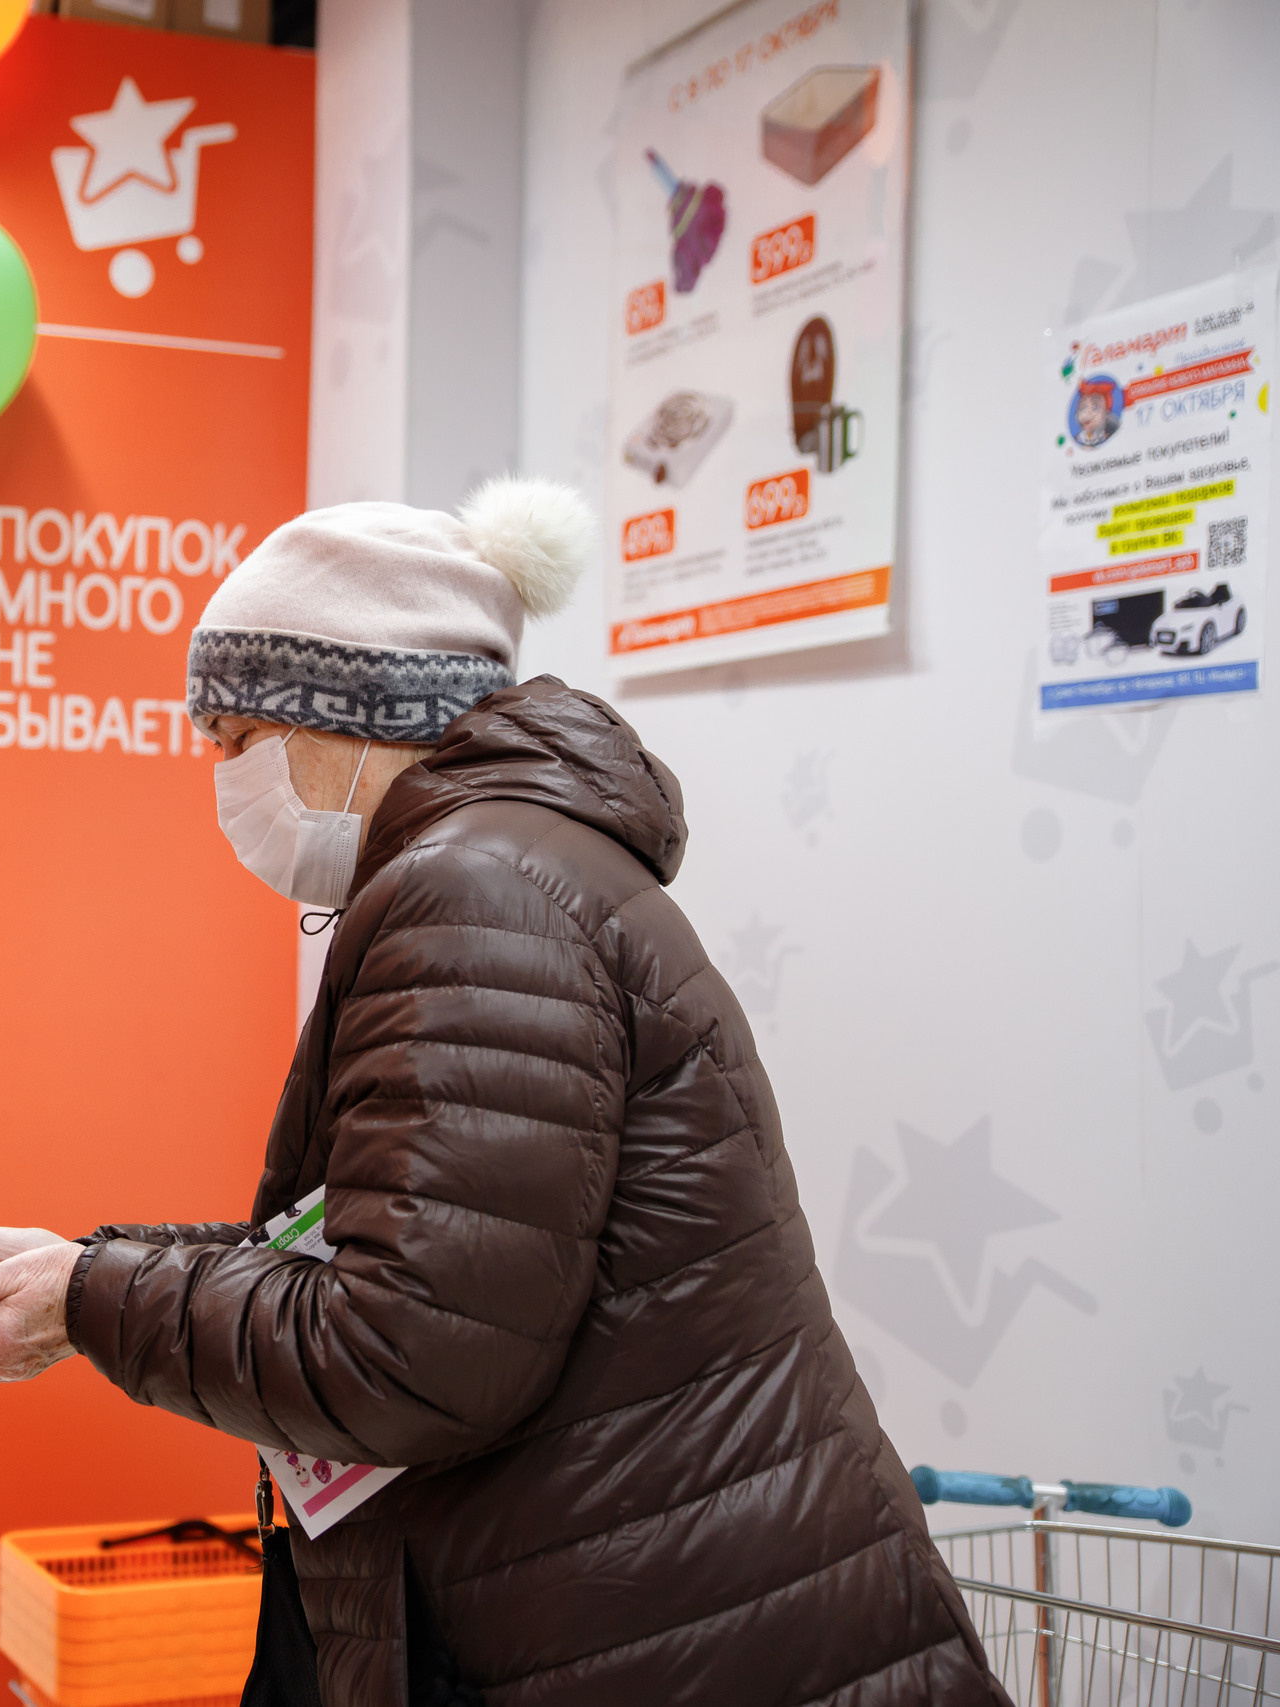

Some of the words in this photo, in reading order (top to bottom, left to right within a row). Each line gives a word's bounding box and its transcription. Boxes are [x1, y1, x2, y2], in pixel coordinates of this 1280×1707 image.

[1080, 322, 1188, 369] Галамарт
[1160, 379, 1246, 422] ОКТЯБРЯ
[275, 1228, 300, 1249] Спорт
